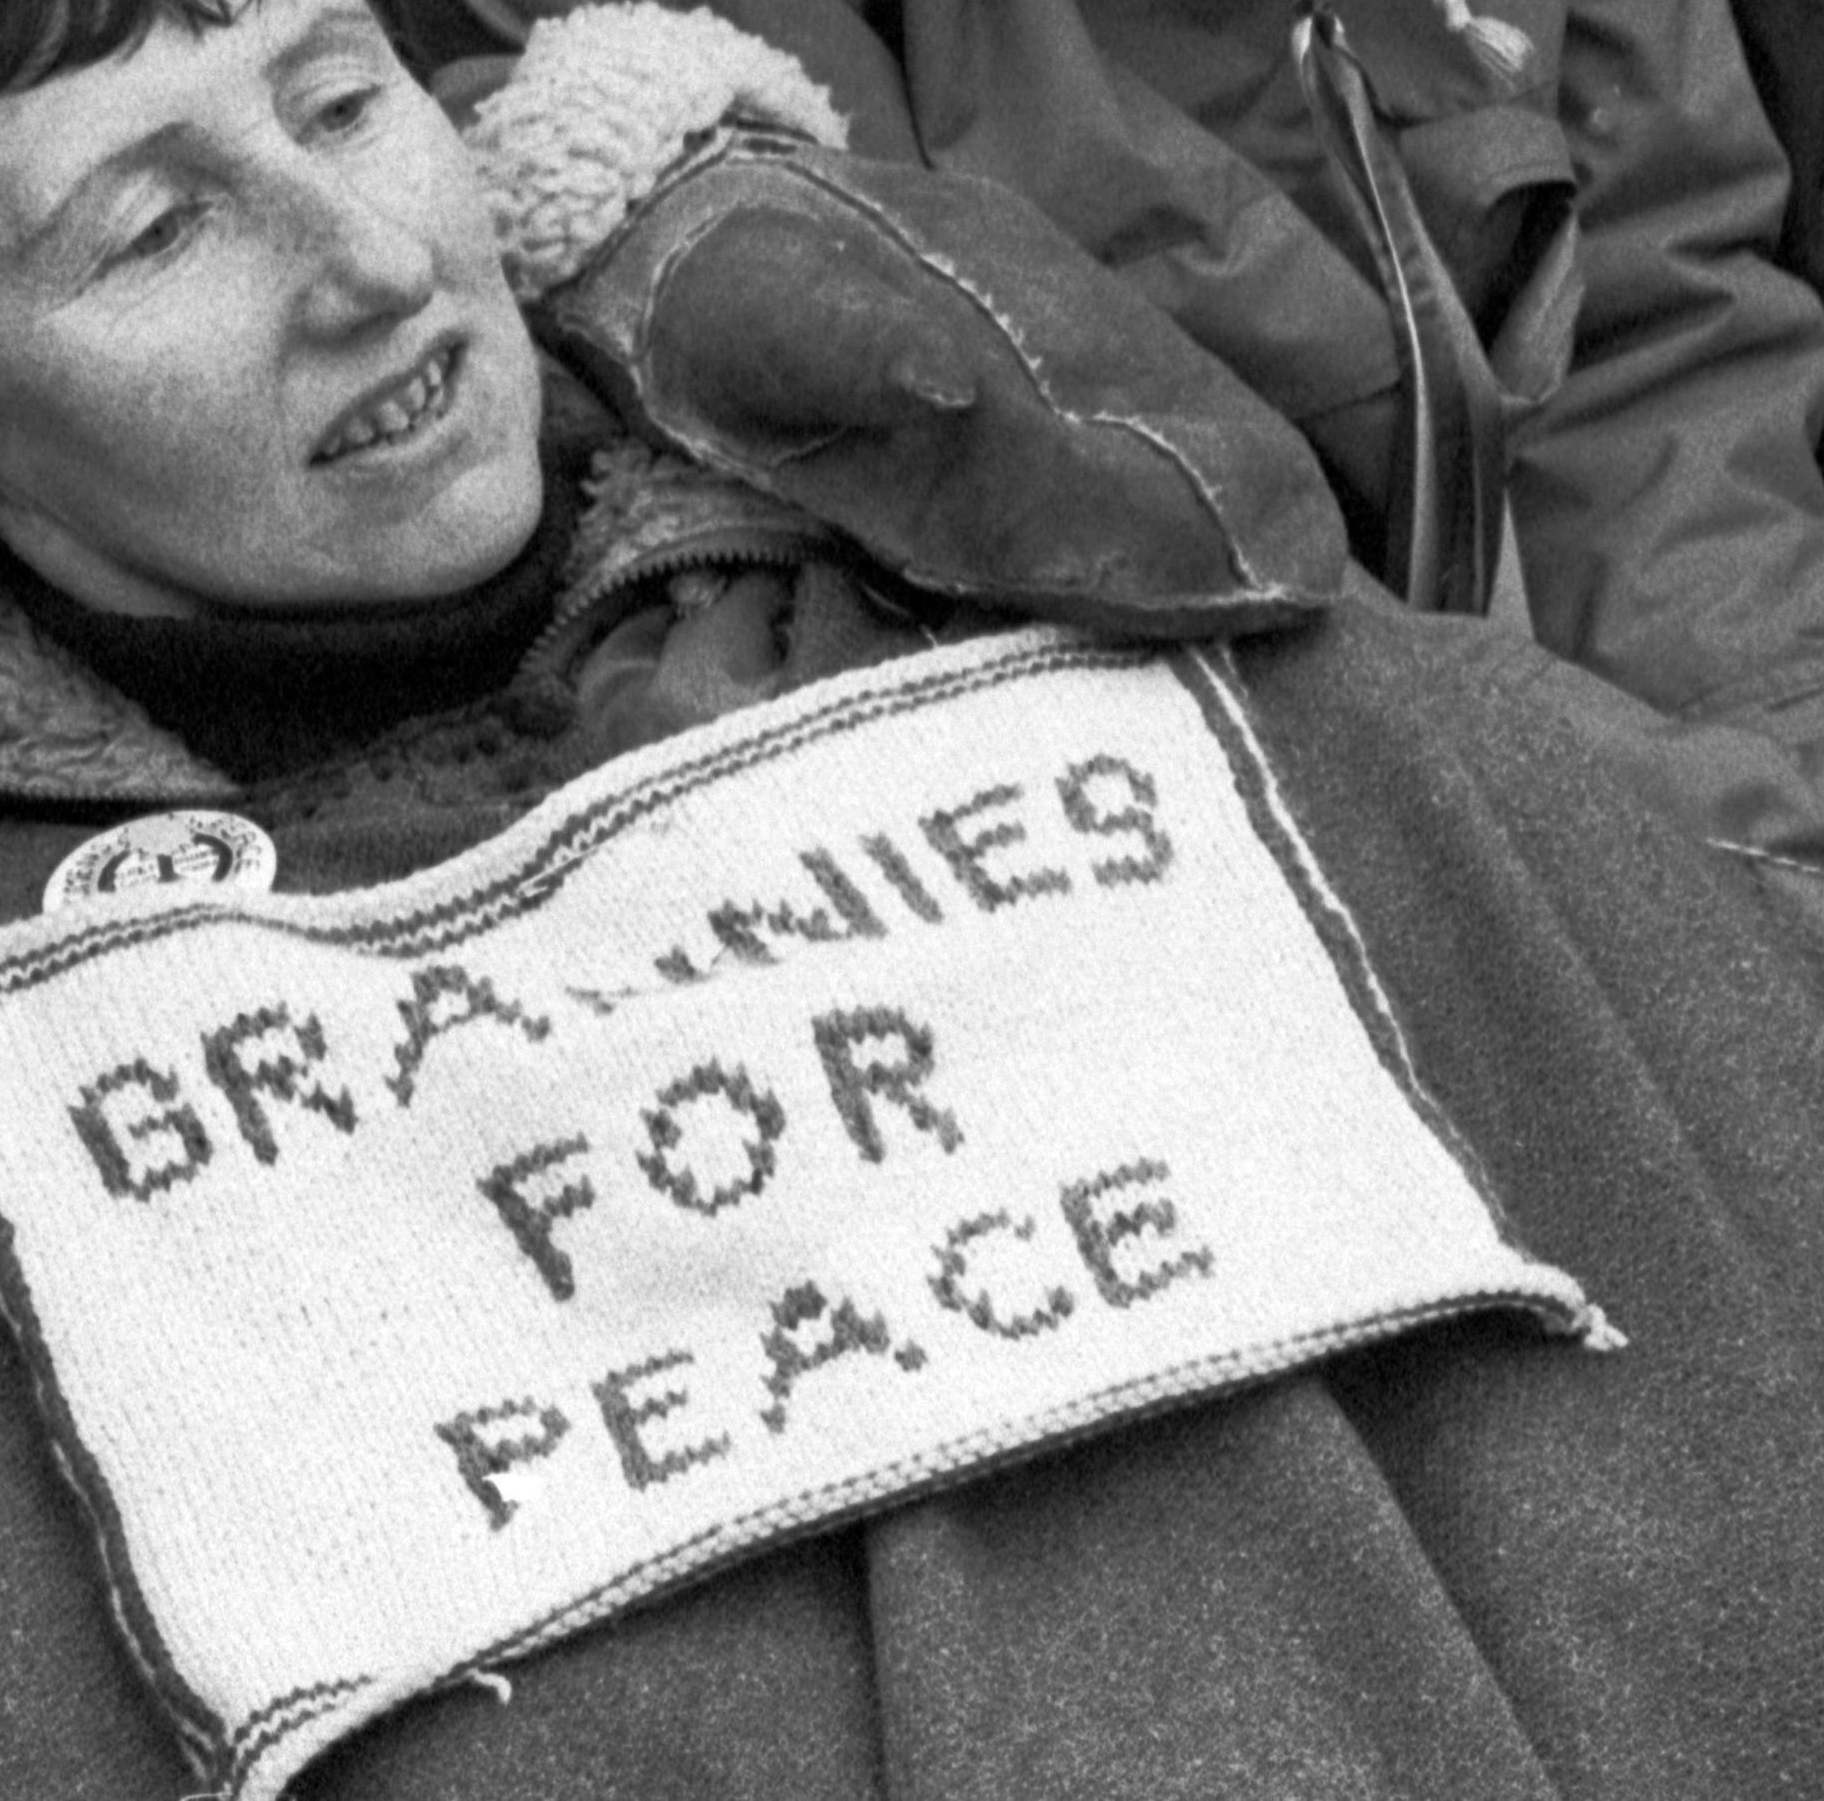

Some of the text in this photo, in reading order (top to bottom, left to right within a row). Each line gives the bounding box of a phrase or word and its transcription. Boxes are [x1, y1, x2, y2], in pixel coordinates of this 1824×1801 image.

[69, 751, 1173, 1202] GRANIES
[476, 1006, 966, 1302] FOR
[436, 1154, 1215, 1530] PEACE
